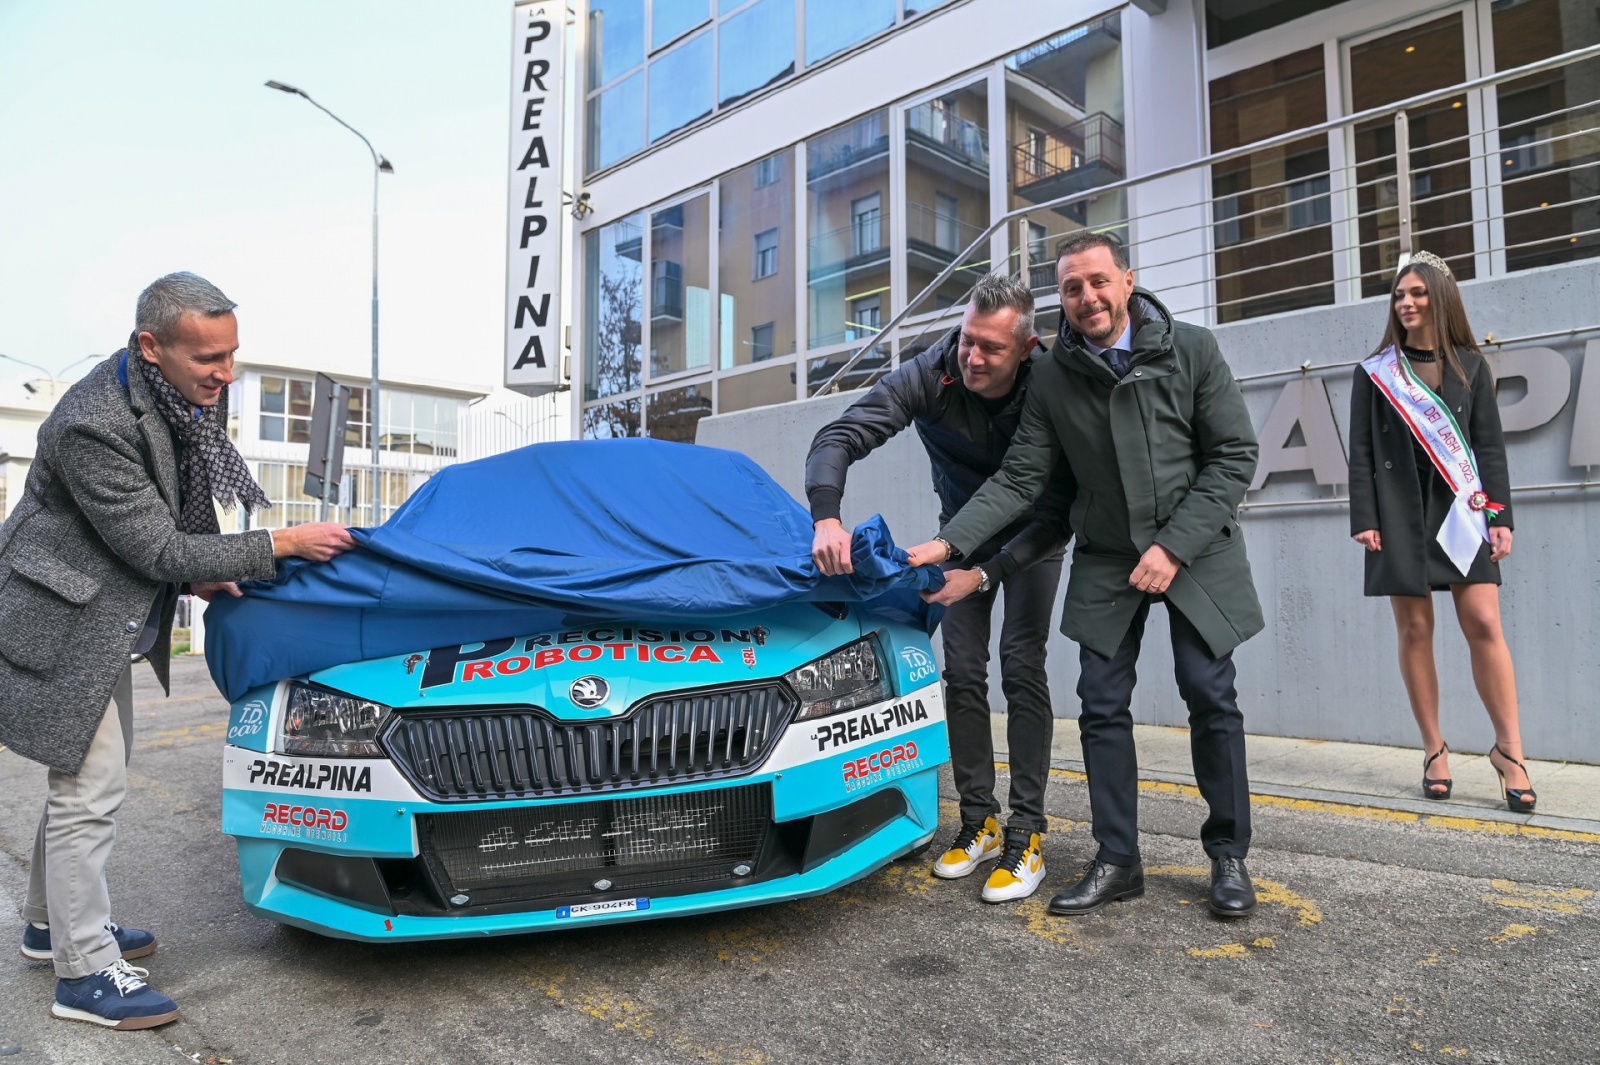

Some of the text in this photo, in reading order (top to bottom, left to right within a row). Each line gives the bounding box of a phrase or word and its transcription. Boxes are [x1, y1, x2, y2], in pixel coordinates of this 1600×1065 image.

[530, 8, 545, 17] LA
[512, 20, 551, 370] PREALPINA
[1424, 406, 1441, 424] DEI
[1437, 425, 1461, 454] LAGHI
[1458, 460, 1475, 484] 2023
[461, 642, 722, 682] ROBOTICA
[741, 646, 757, 666] SRL
[817, 699, 928, 752] PREALPINA
[250, 759, 372, 793] PREALPINA
[842, 741, 919, 783] RECORD
[263, 802, 348, 831] RECORD
